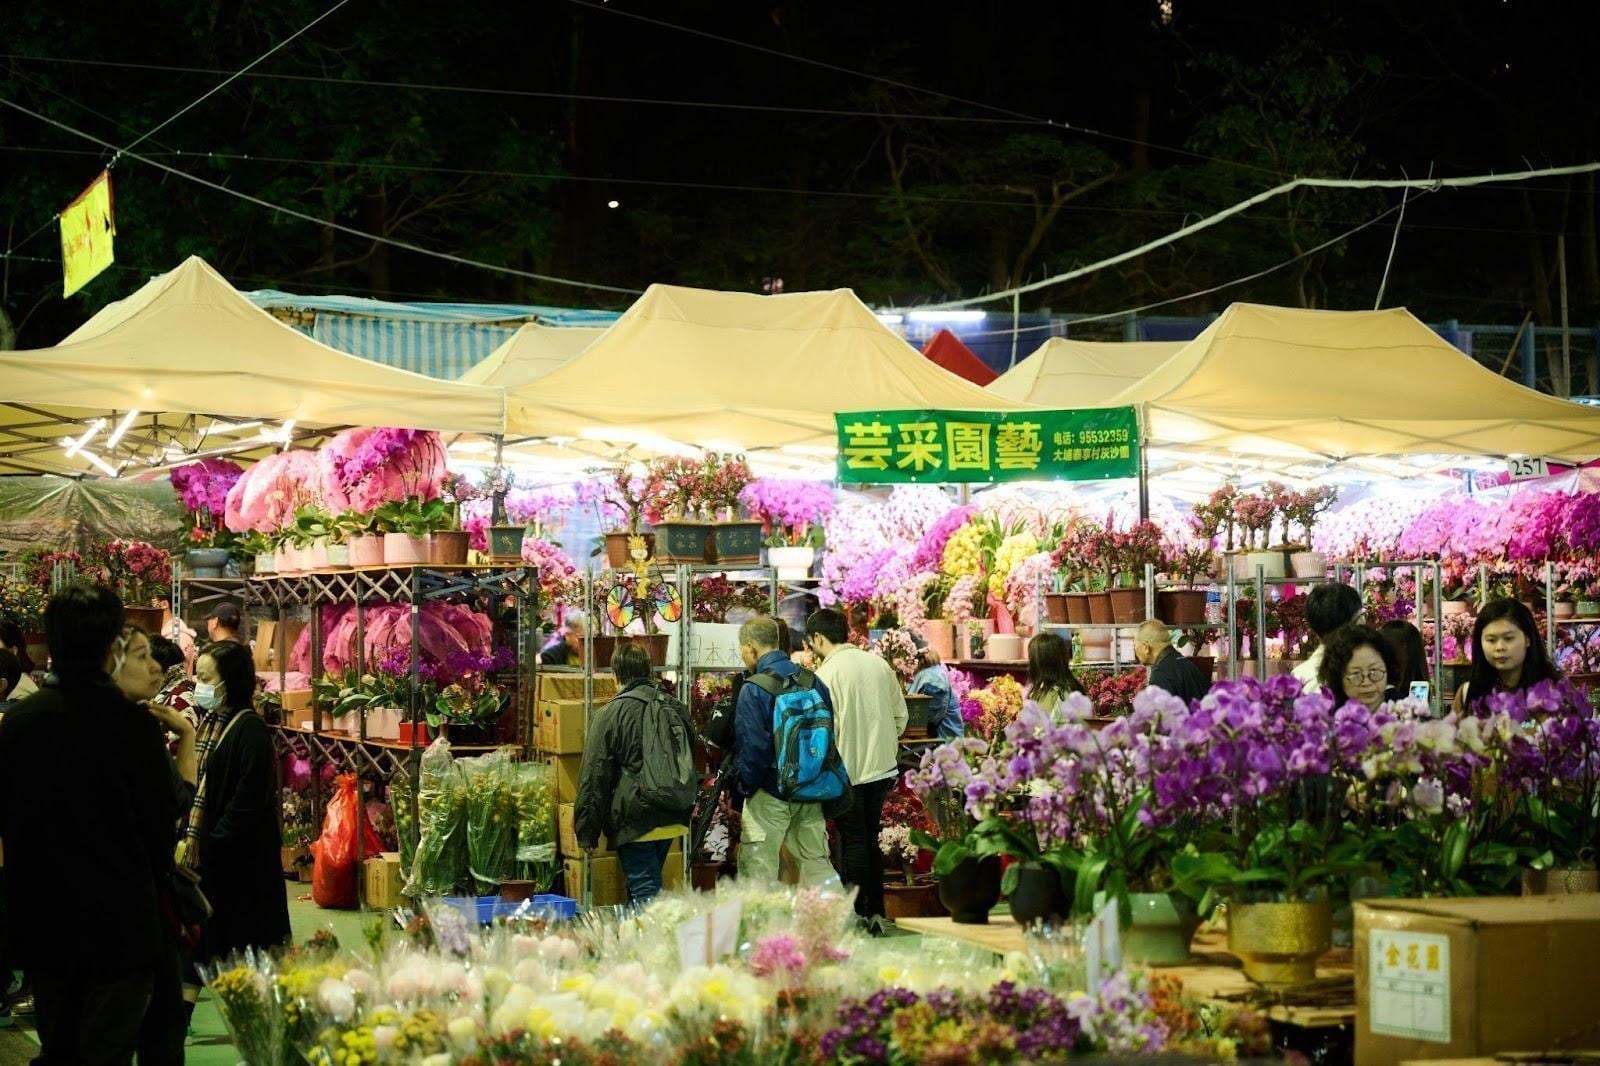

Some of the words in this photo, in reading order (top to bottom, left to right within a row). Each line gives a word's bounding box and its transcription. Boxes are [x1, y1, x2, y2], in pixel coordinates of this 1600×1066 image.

[1079, 428, 1129, 444] 95532359
[844, 422, 1042, 470] 芸采園藝
[1511, 458, 1542, 475] 257
